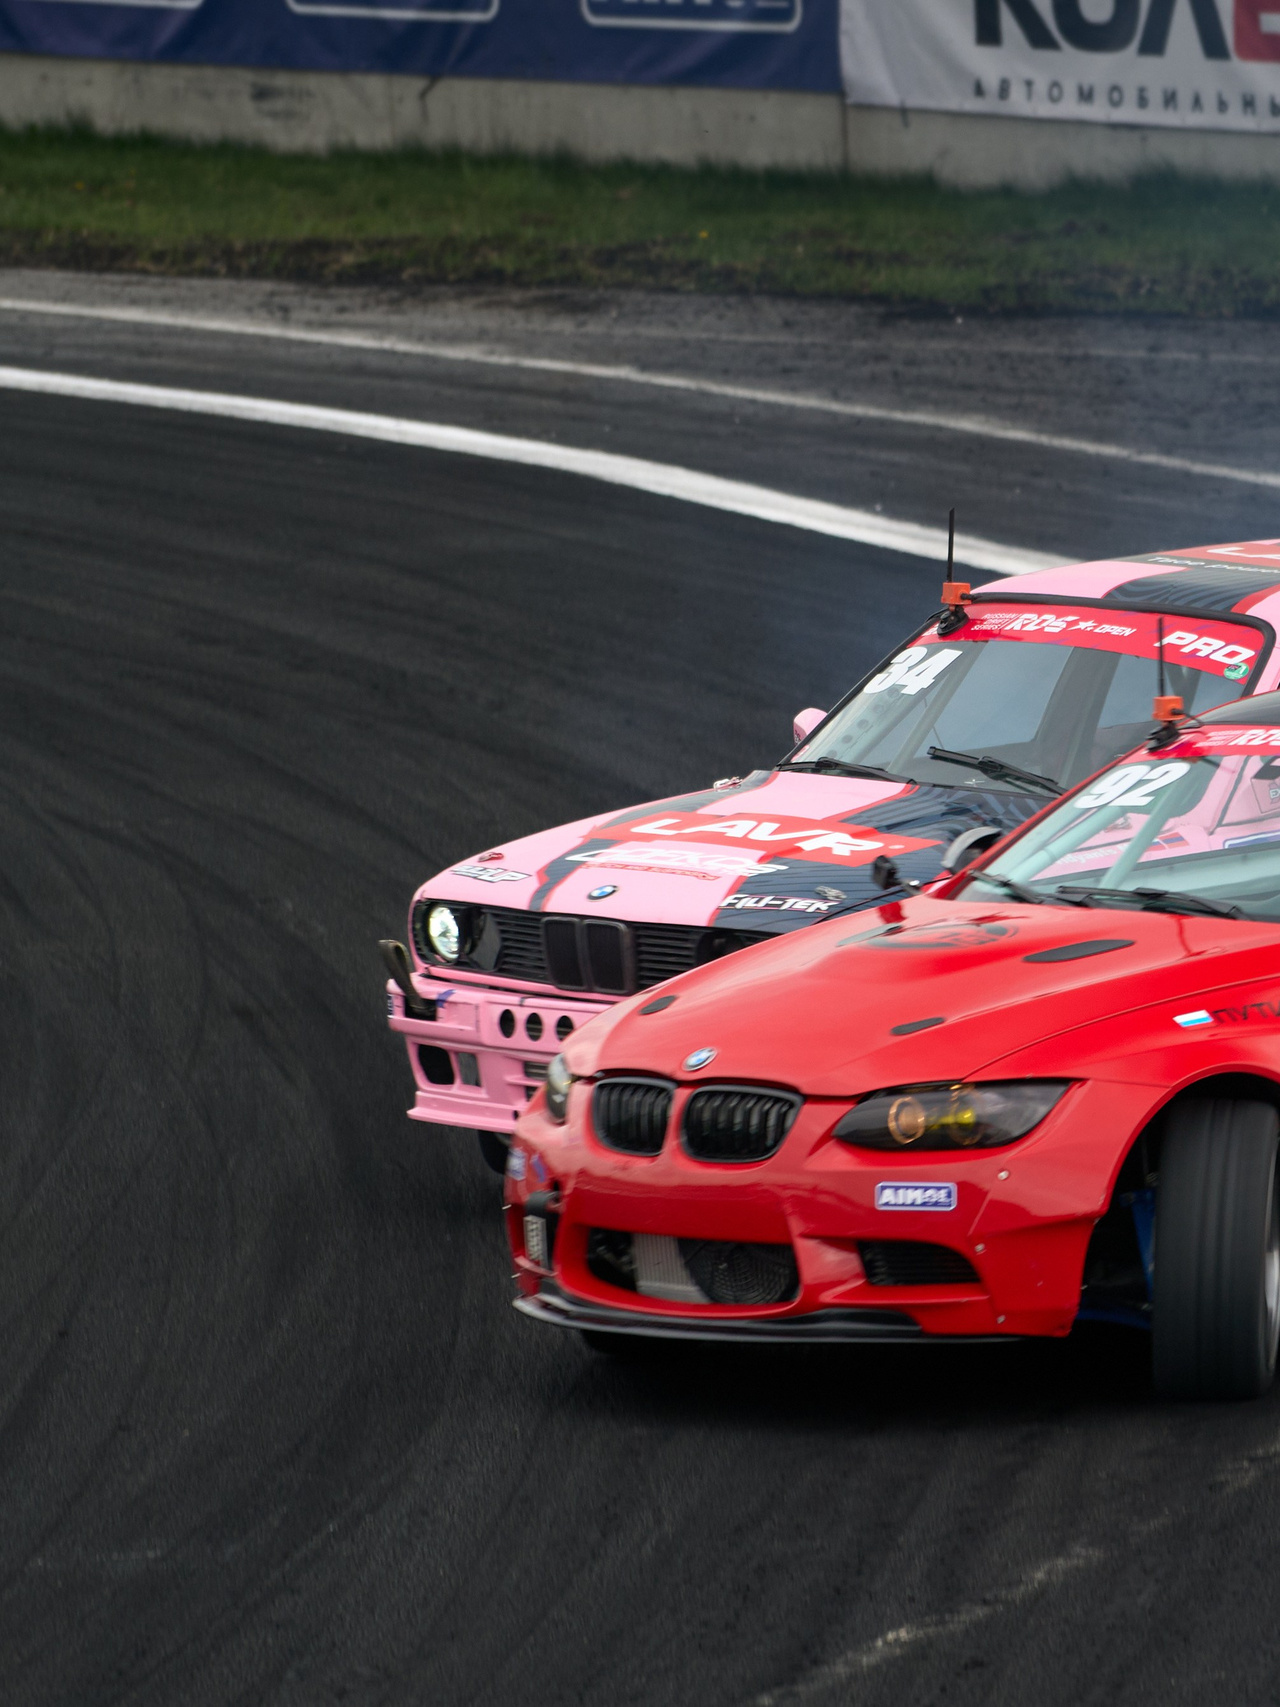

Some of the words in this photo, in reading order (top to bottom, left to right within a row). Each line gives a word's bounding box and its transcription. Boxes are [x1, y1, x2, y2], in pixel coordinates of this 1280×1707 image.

[1004, 613, 1080, 633] RDS
[1093, 624, 1137, 637] OPEN
[1153, 631, 1256, 665] PRO
[863, 645, 963, 696] 34
[1074, 761, 1192, 810] 92
[630, 818, 885, 857] LAVR
